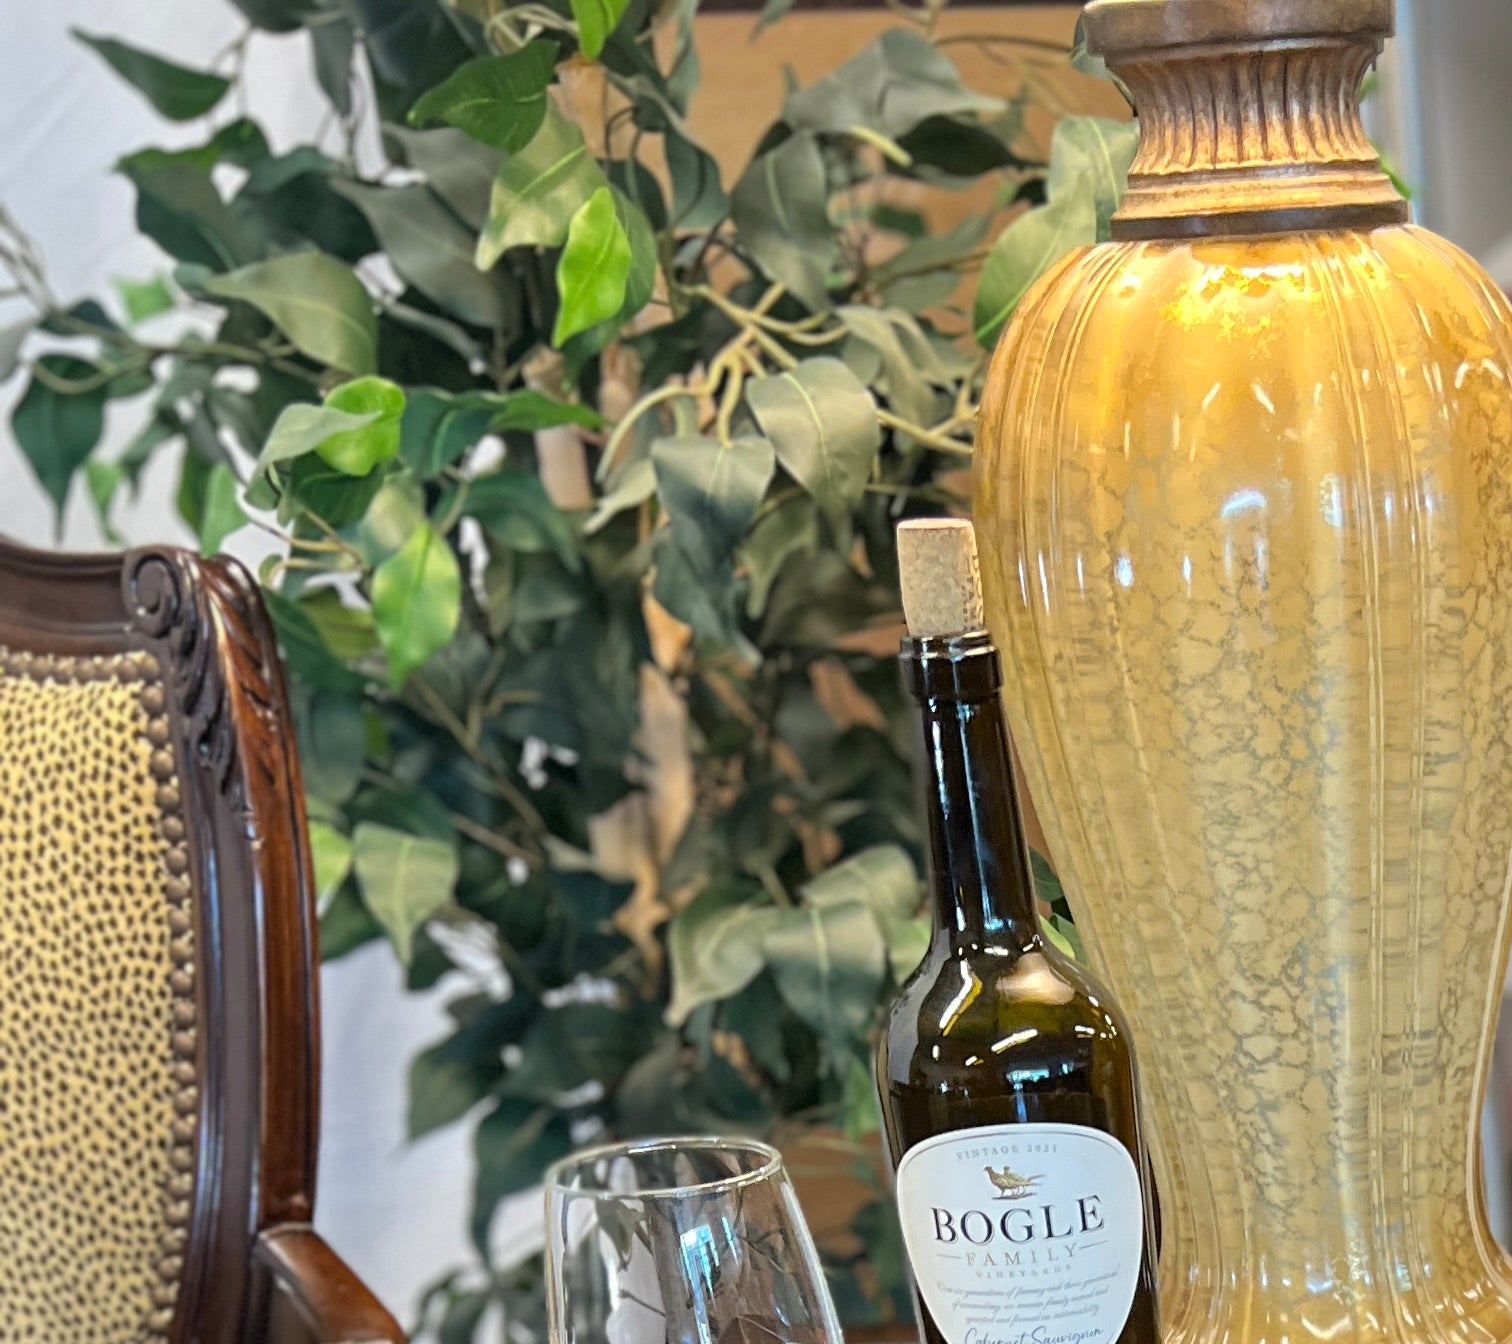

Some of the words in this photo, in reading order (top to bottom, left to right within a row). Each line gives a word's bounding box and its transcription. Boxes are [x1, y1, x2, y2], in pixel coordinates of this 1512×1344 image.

[955, 1143, 1020, 1160] VINTAGE
[930, 1194, 1106, 1246] BOGLE
[966, 1242, 1078, 1267] FAMILY
